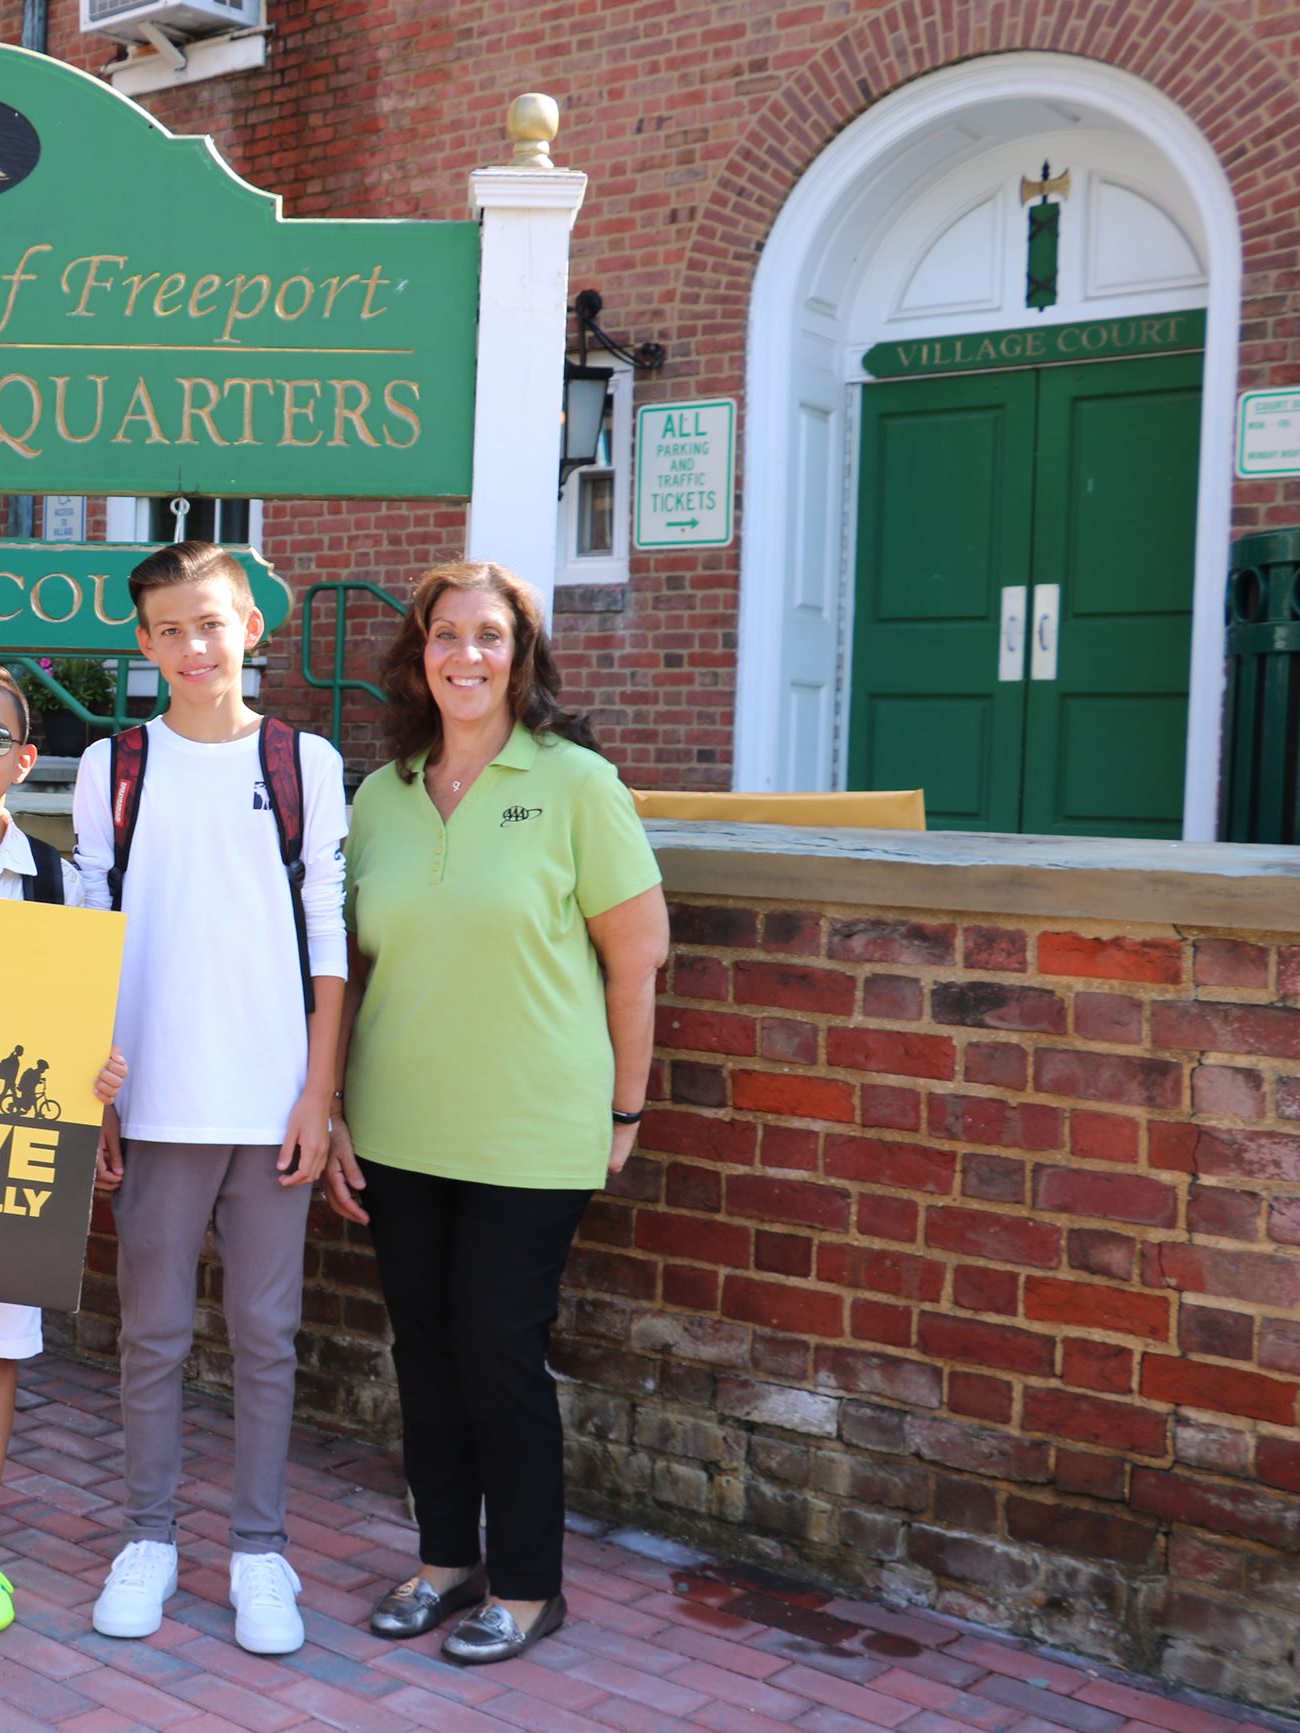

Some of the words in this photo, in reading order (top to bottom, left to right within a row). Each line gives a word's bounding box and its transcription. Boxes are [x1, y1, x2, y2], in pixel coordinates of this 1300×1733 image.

[61, 254, 390, 343] Freeport
[898, 331, 1045, 367] VILLAGE
[1057, 317, 1186, 352] COURT
[661, 412, 708, 438] ALL
[657, 442, 709, 457] PARKING
[670, 458, 695, 471] AND
[657, 473, 706, 488] TRAFFIC
[652, 490, 716, 512] TICKETS
